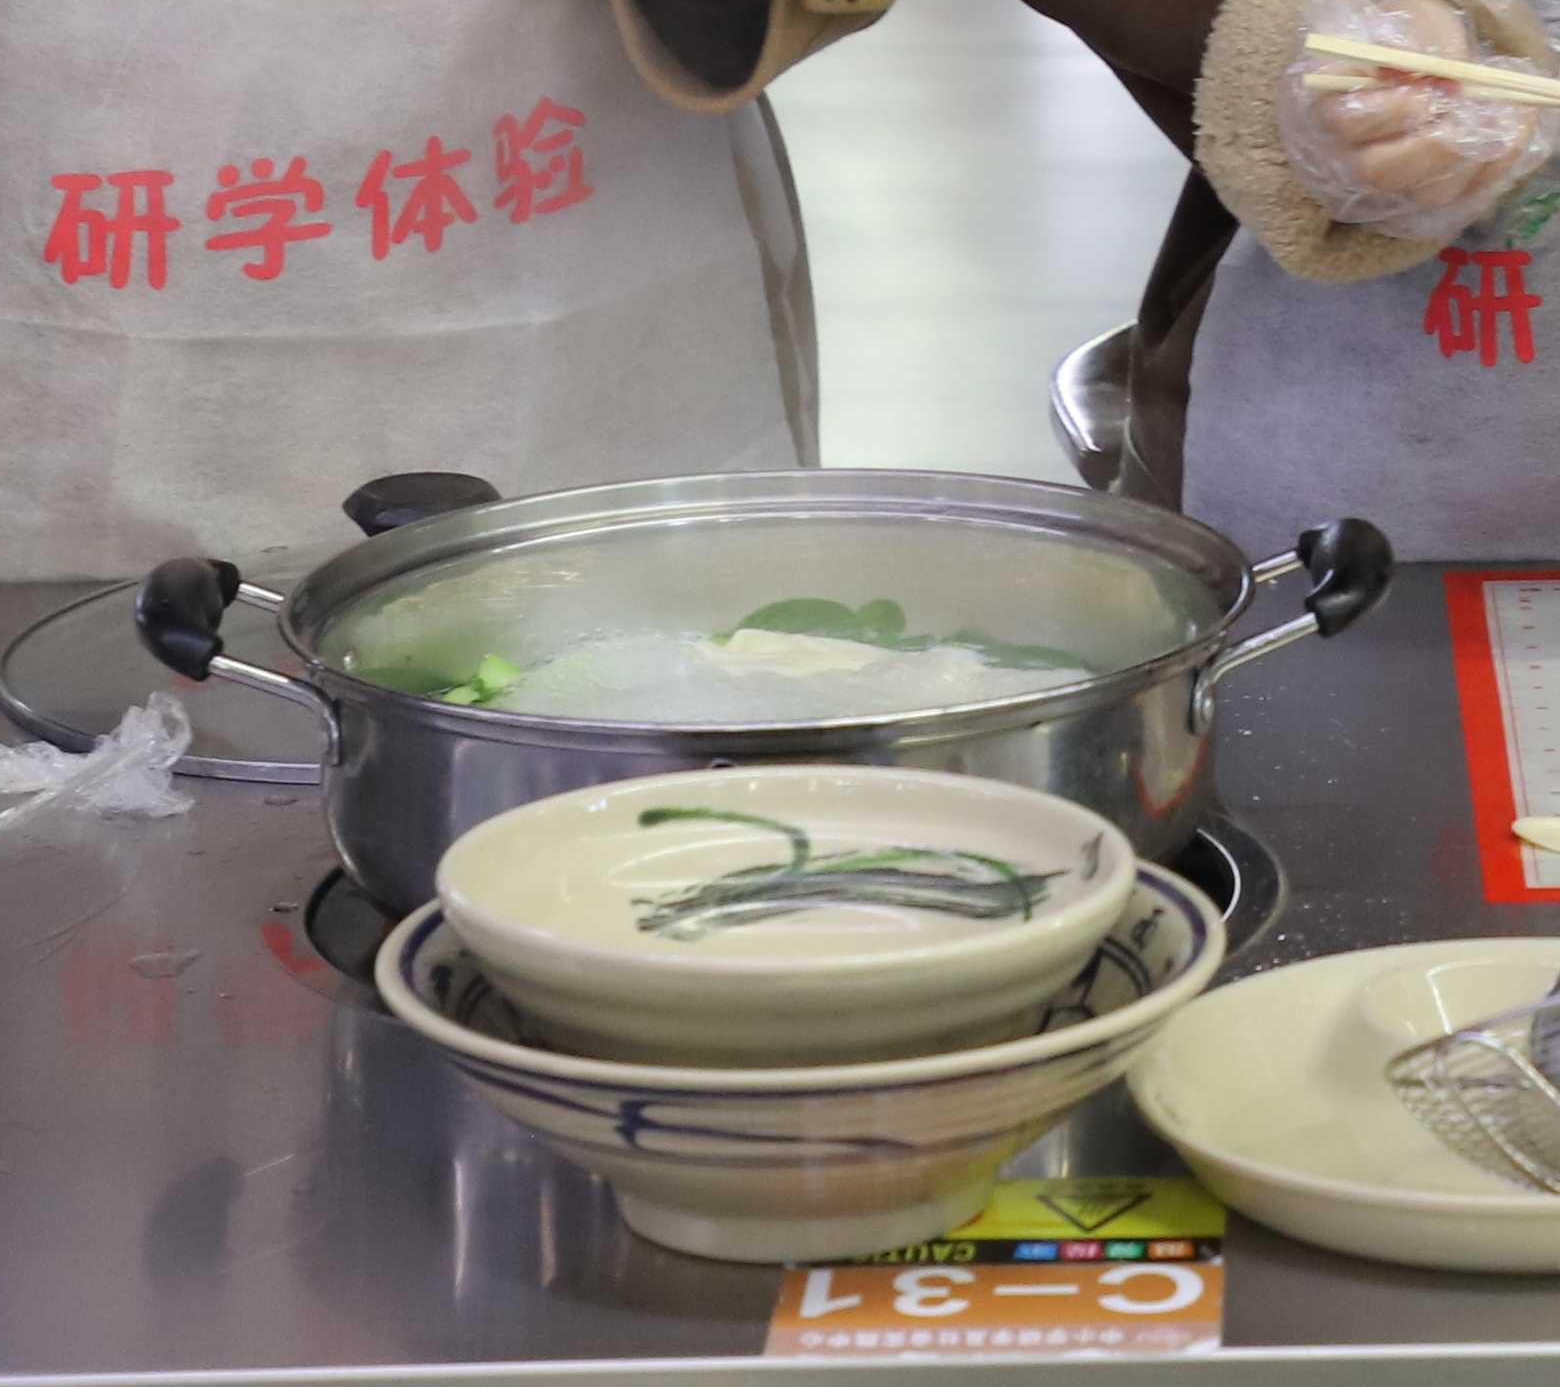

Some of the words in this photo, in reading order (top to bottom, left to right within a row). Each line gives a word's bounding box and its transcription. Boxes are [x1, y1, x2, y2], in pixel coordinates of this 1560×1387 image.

[43, 95, 594, 290] 研学体验
[798, 1262, 1205, 1320] C-31
